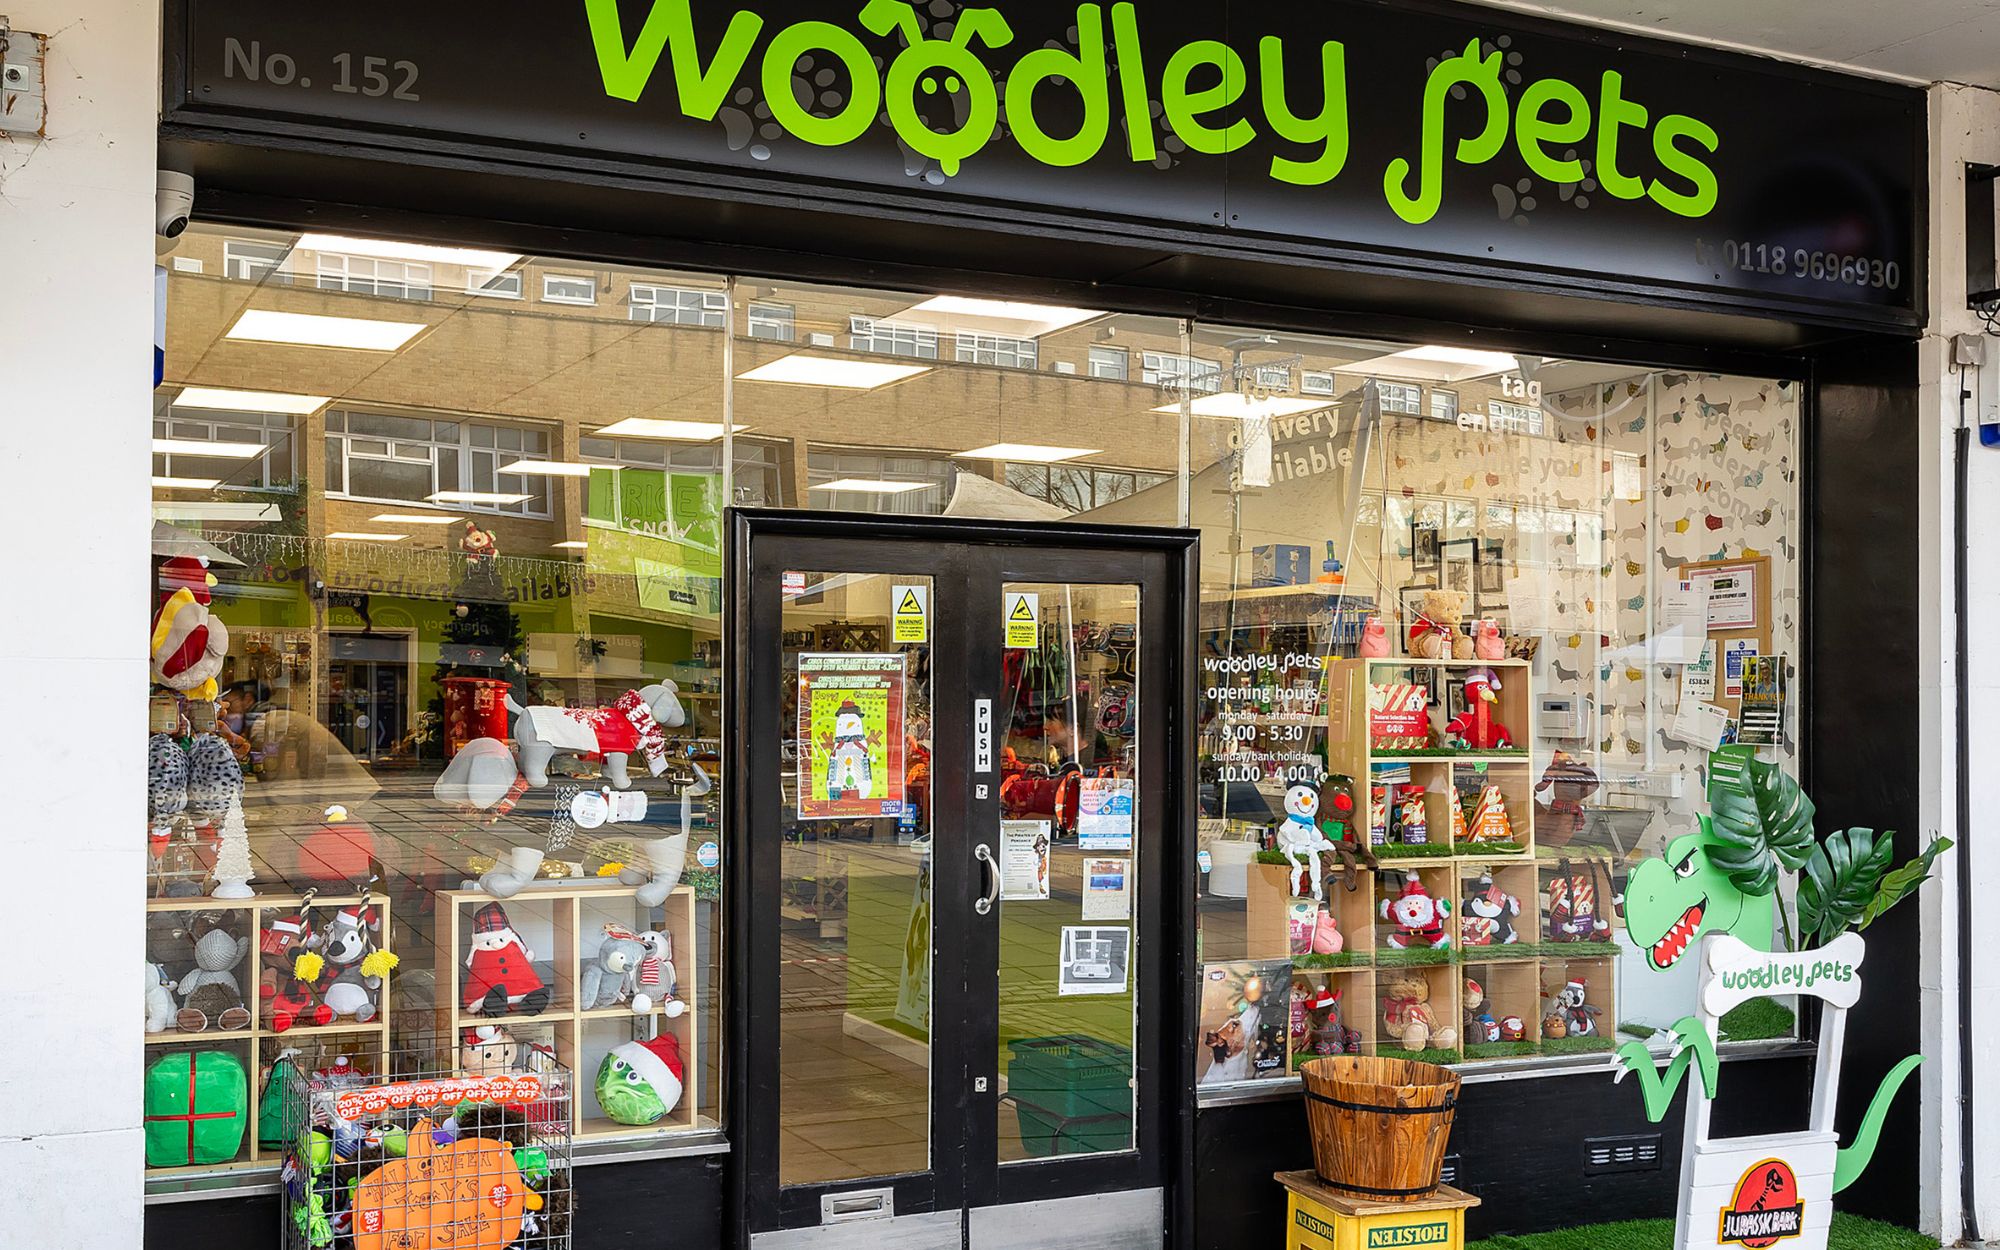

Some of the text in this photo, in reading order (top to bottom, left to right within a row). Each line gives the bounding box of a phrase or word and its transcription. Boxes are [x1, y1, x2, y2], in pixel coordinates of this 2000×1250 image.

[224, 37, 420, 101] No. 152
[584, 0, 1719, 225] woodley pets
[1722, 239, 1787, 275] 0118
[1794, 248, 1900, 290] 9696930
[1500, 374, 1542, 407] tag
[1227, 408, 1340, 450] divery
[604, 482, 698, 518] PRICE
[1203, 652, 1322, 674] woodley pets
[1207, 684, 1318, 703] opening hours
[1219, 712, 1258, 721] monday
[1266, 711, 1307, 721] saturday
[978, 706, 988, 766] PUSH
[1222, 725, 1256, 740] 9.00
[1270, 725, 1303, 740] 5.30
[1212, 751, 1312, 762] sunday/bank holiday
[1217, 766, 1260, 782] 10.00
[1274, 766, 1307, 781] 4.00
[1722, 960, 1852, 990] woodley pets
[415, 1085, 439, 1094] 20%
[441, 1083, 465, 1092] 20%
[466, 1080, 490, 1089] 20%
[490, 1081, 514, 1090] 20%
[516, 1081, 539, 1090] 20%
[390, 1086, 414, 1095] 20%
[442, 1091, 463, 1100] OFF
[466, 1089, 487, 1098] OFF
[491, 1090, 512, 1098] OFF
[517, 1089, 537, 1098] OFF
[363, 1091, 388, 1102] 20%
[391, 1094, 413, 1104] OFF
[416, 1094, 437, 1103] OFF
[338, 1097, 364, 1108] 20%
[365, 1100, 387, 1110] OFF
[340, 1106, 363, 1117] OFF
[1296, 1211, 1333, 1240] HOLSTEN
[1771, 1211, 1798, 1233] BARK
[437, 1213, 491, 1244] SALE
[1370, 1225, 1446, 1246] HOLSTEN
